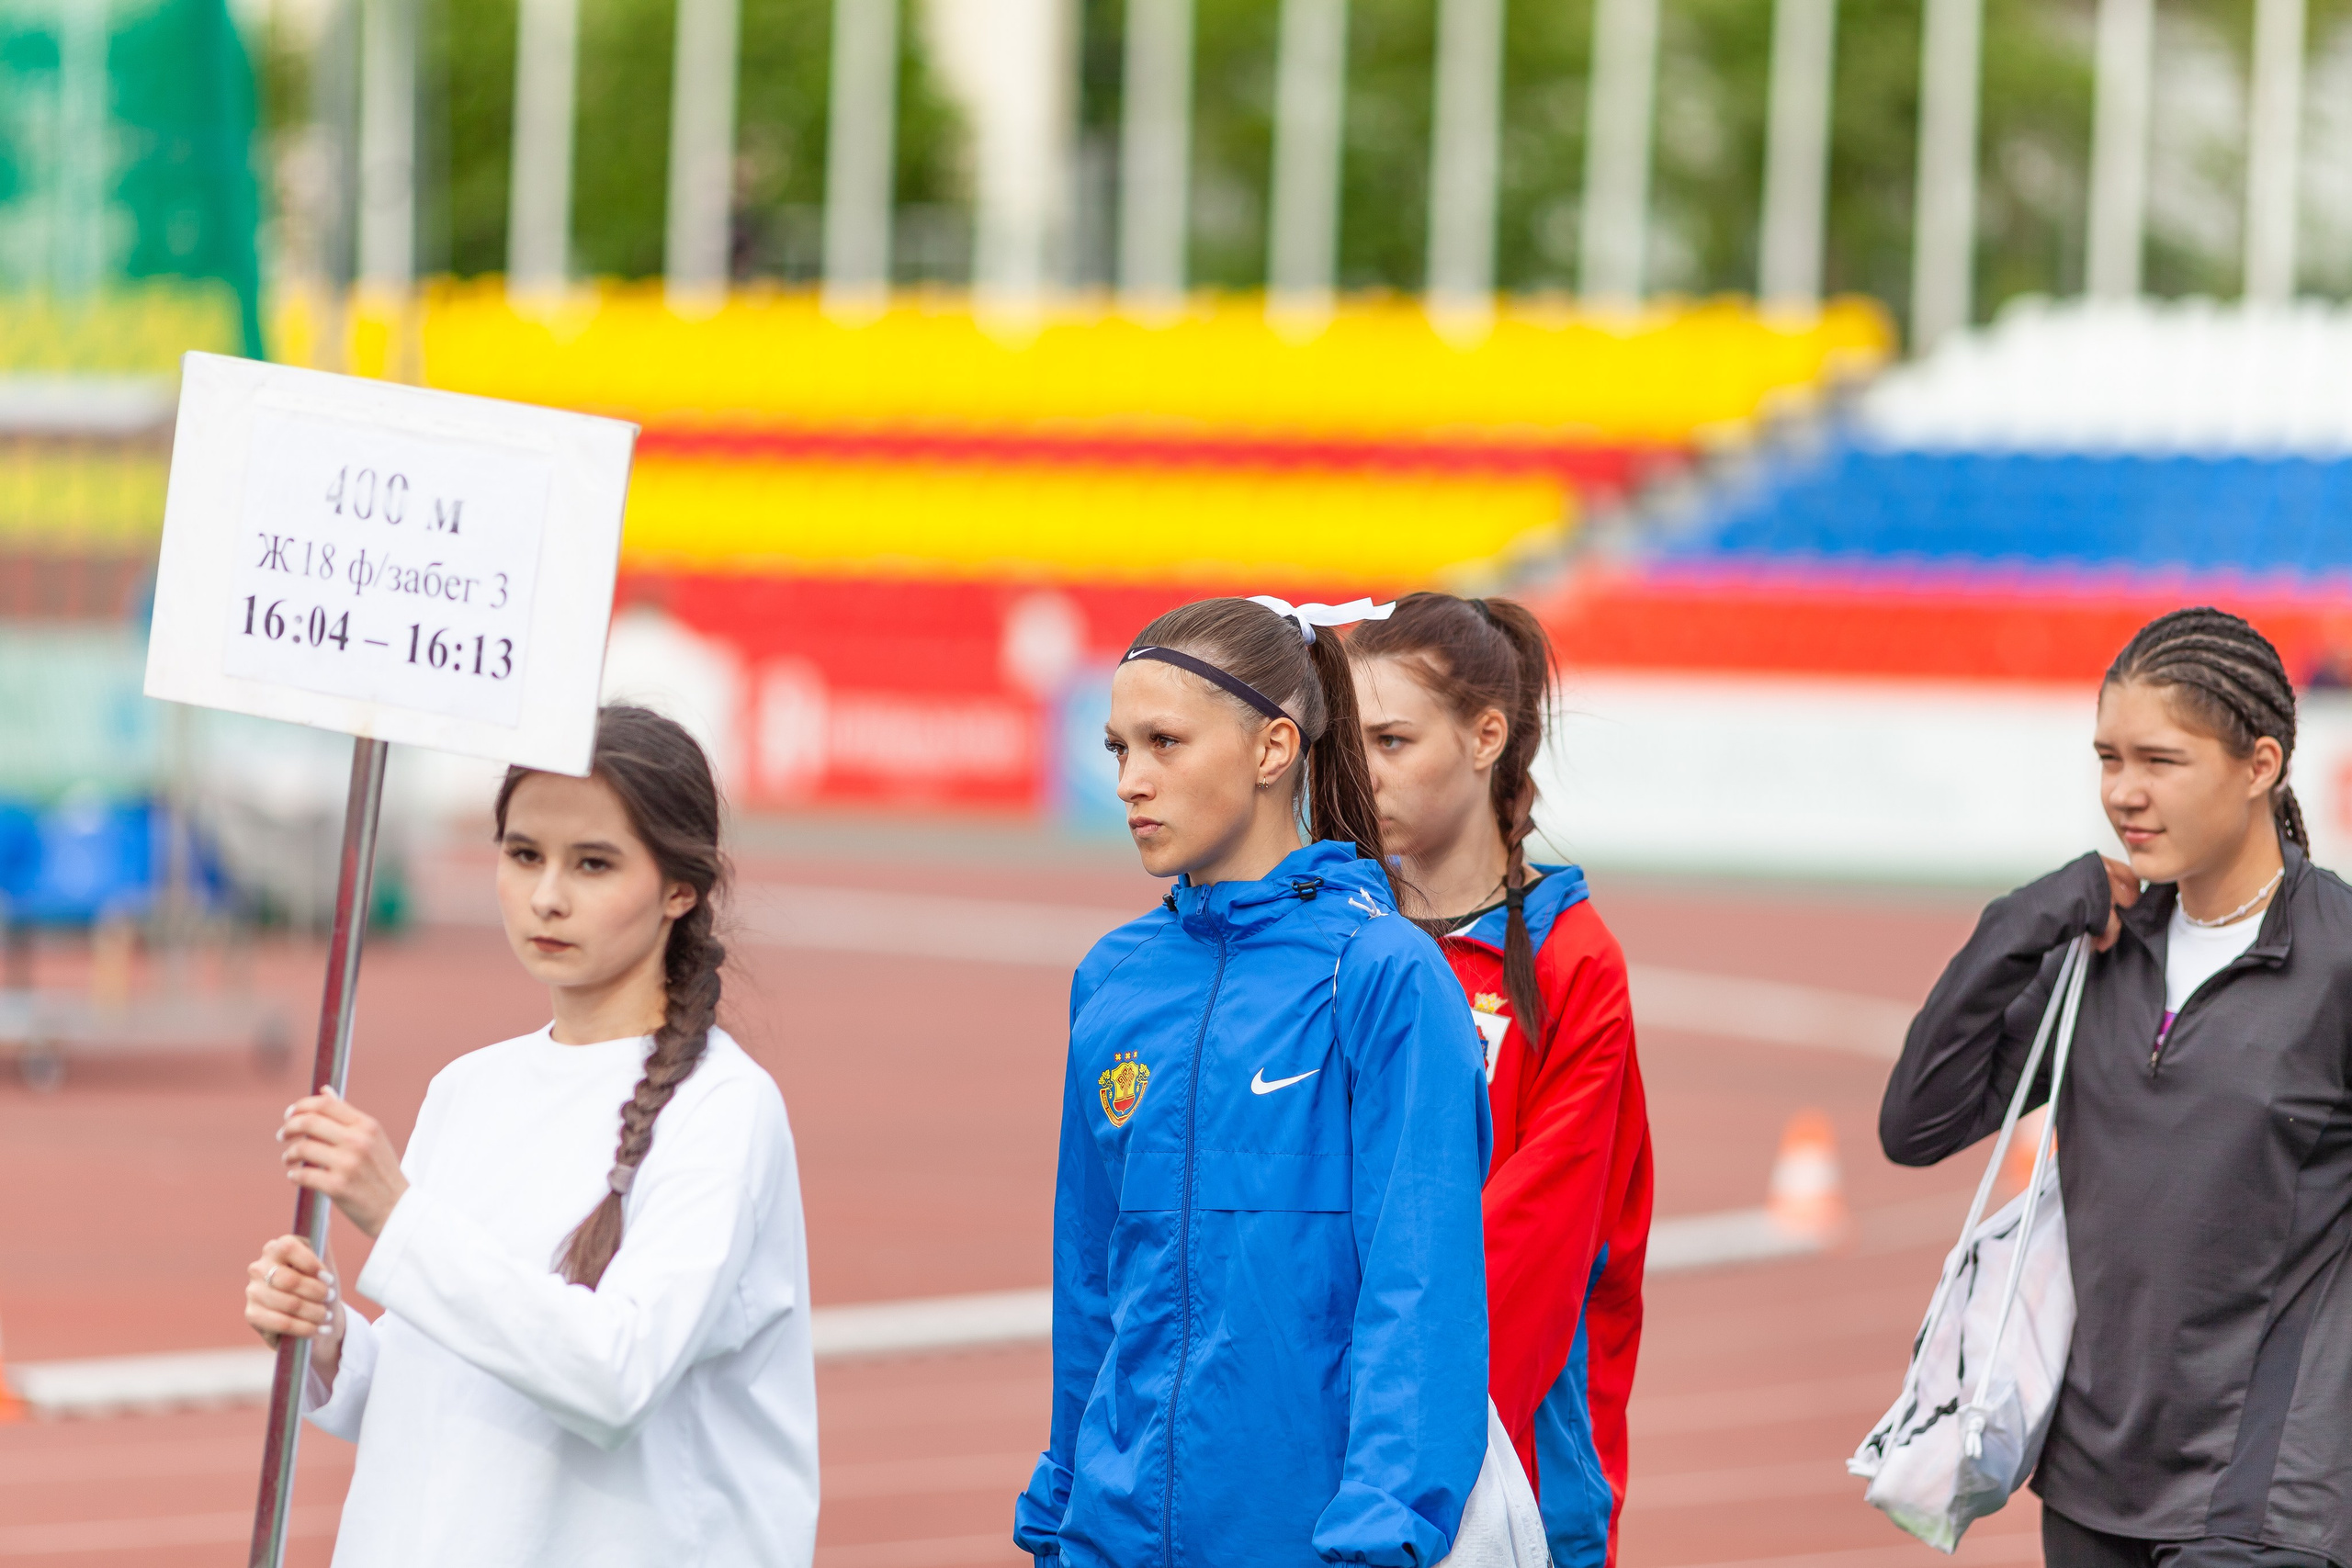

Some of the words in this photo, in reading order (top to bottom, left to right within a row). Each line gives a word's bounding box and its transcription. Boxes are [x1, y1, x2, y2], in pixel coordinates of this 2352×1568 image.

[326, 465, 409, 525] 400
[426, 497, 464, 535] м
[256, 533, 336, 581] Ж18
[348, 548, 480, 604] ф/забег
[489, 572, 509, 610] 3
[242, 594, 350, 651] 16:04
[406, 623, 514, 681] 16:13
